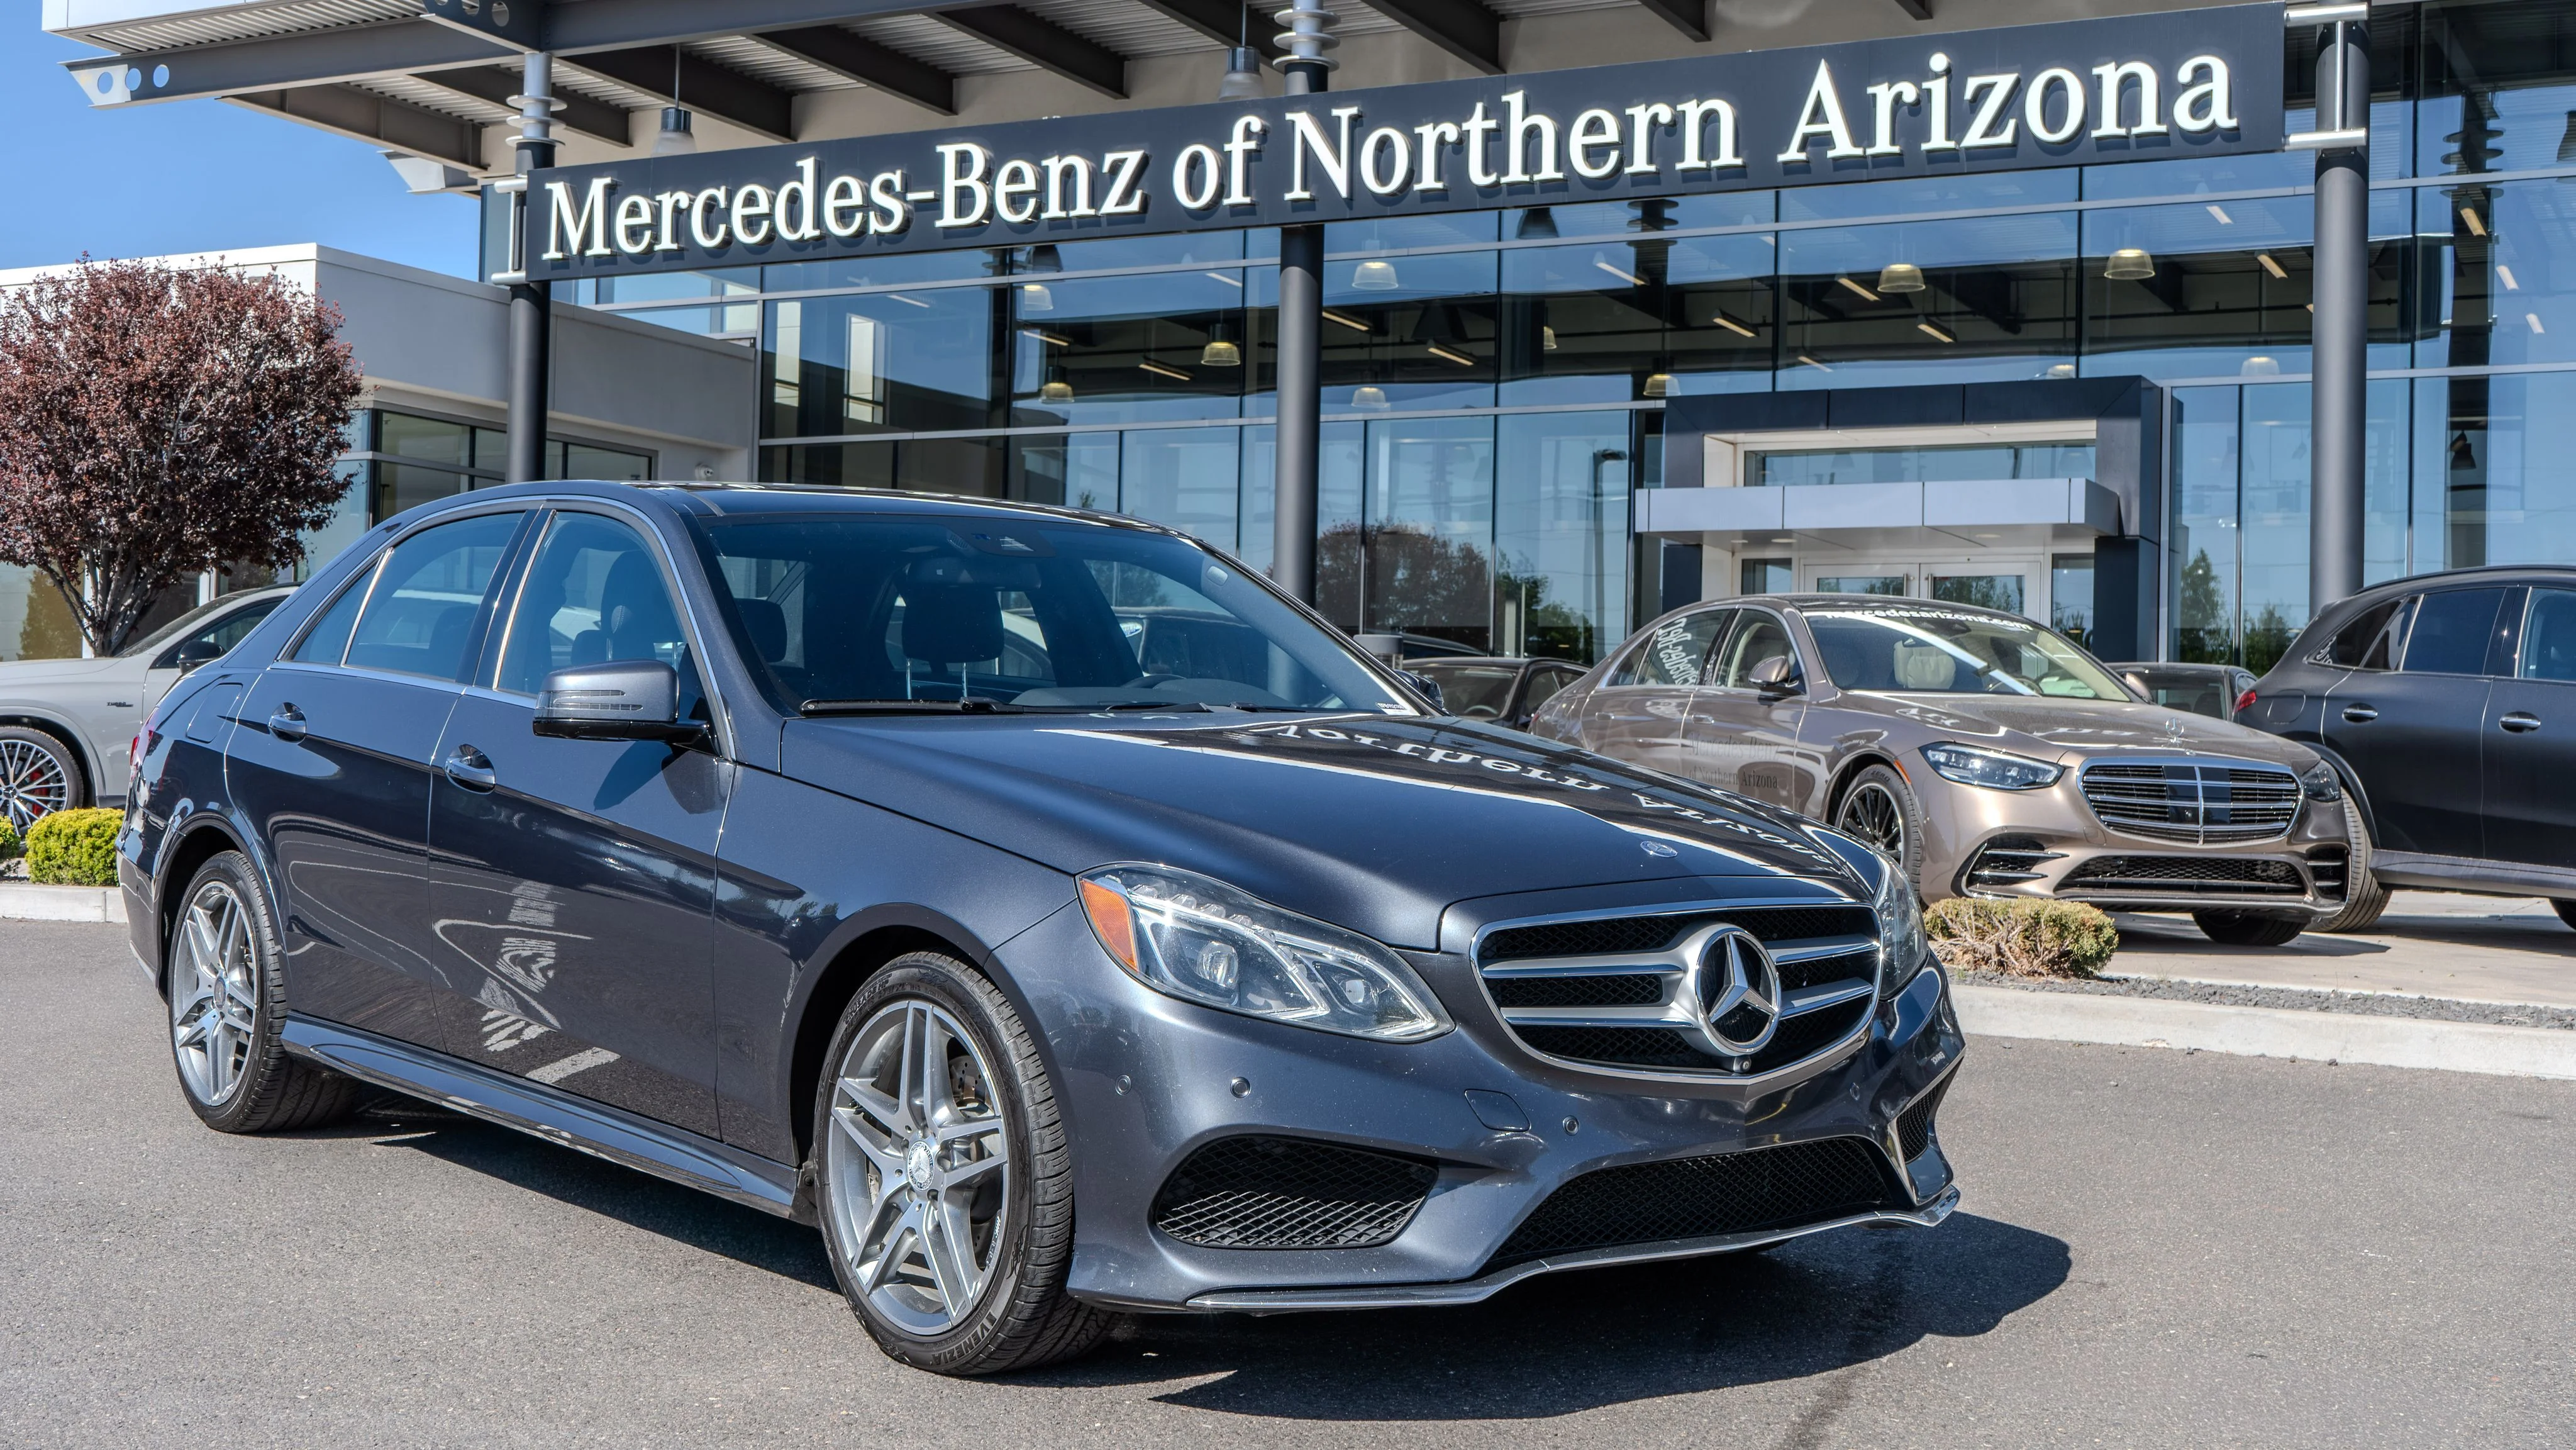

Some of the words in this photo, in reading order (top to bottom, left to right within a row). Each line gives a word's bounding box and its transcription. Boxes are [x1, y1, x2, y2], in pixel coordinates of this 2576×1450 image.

[542, 143, 1148, 260] Mercedes-Benz
[1173, 115, 1263, 209] of
[1284, 89, 1745, 201] Northern
[1777, 53, 2240, 162] Arizona
[1824, 609, 2033, 632] rcedesarizona.com
[1689, 765, 1697, 778] of
[1699, 766, 1739, 786] Northern
[1741, 769, 1778, 788] Arizona
[931, 1322, 991, 1366] VENEZIA
